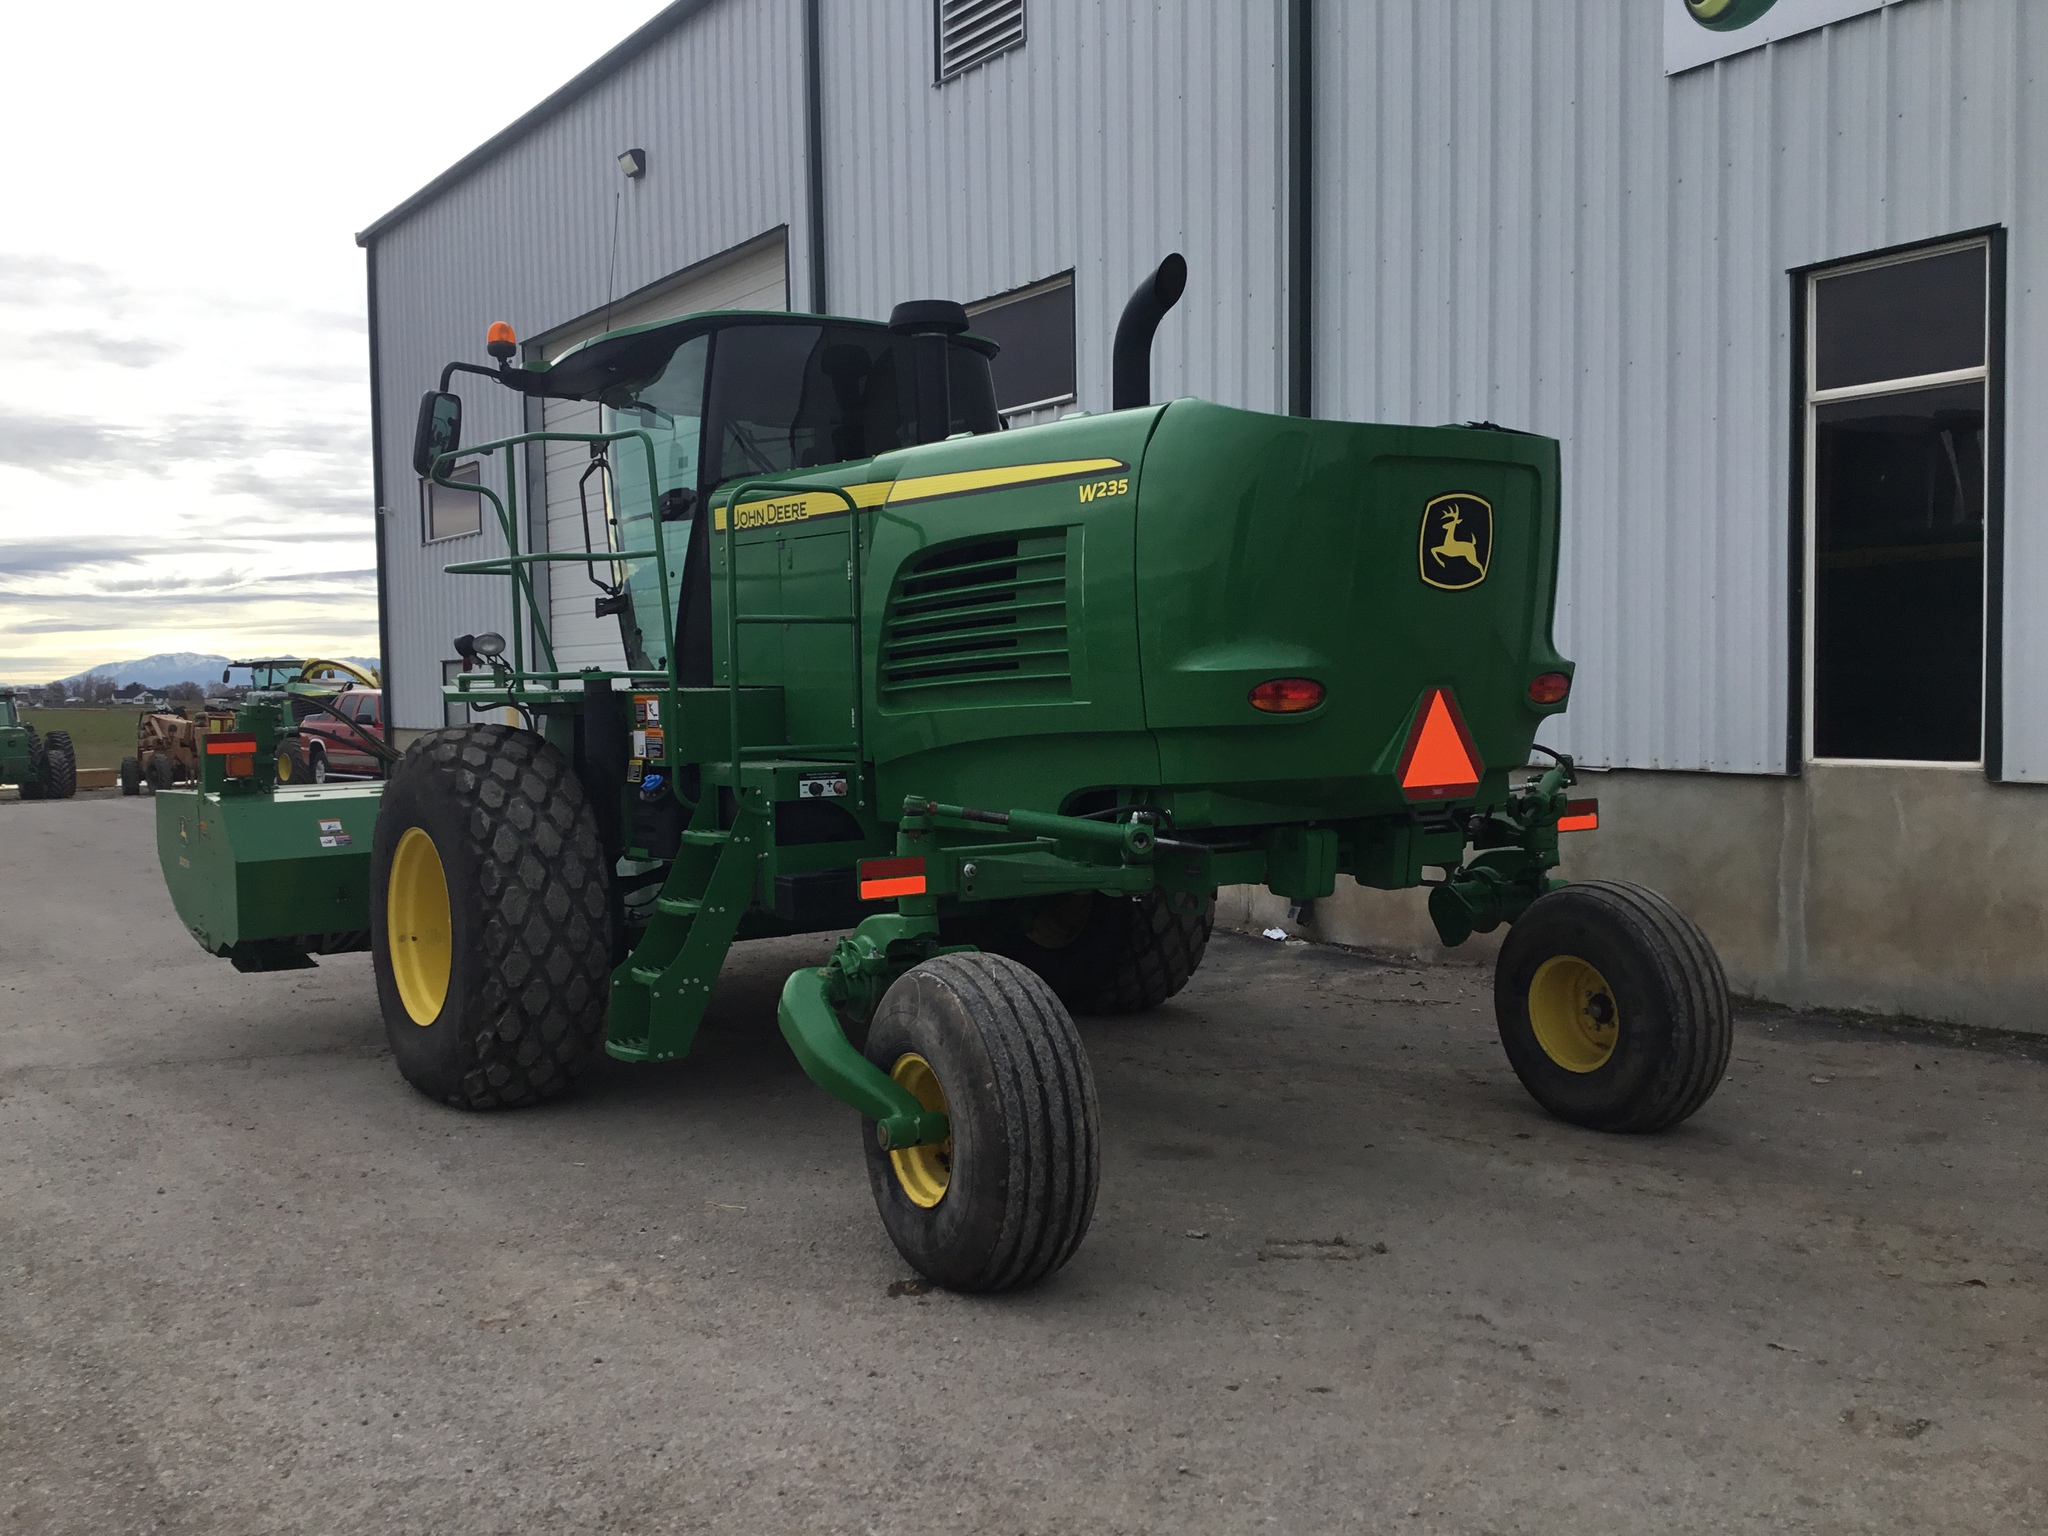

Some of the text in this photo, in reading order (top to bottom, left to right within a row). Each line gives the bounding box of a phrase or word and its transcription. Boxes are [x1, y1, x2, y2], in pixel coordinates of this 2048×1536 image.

[1079, 478, 1129, 503] W235
[734, 501, 807, 527] JOHN DEERE
